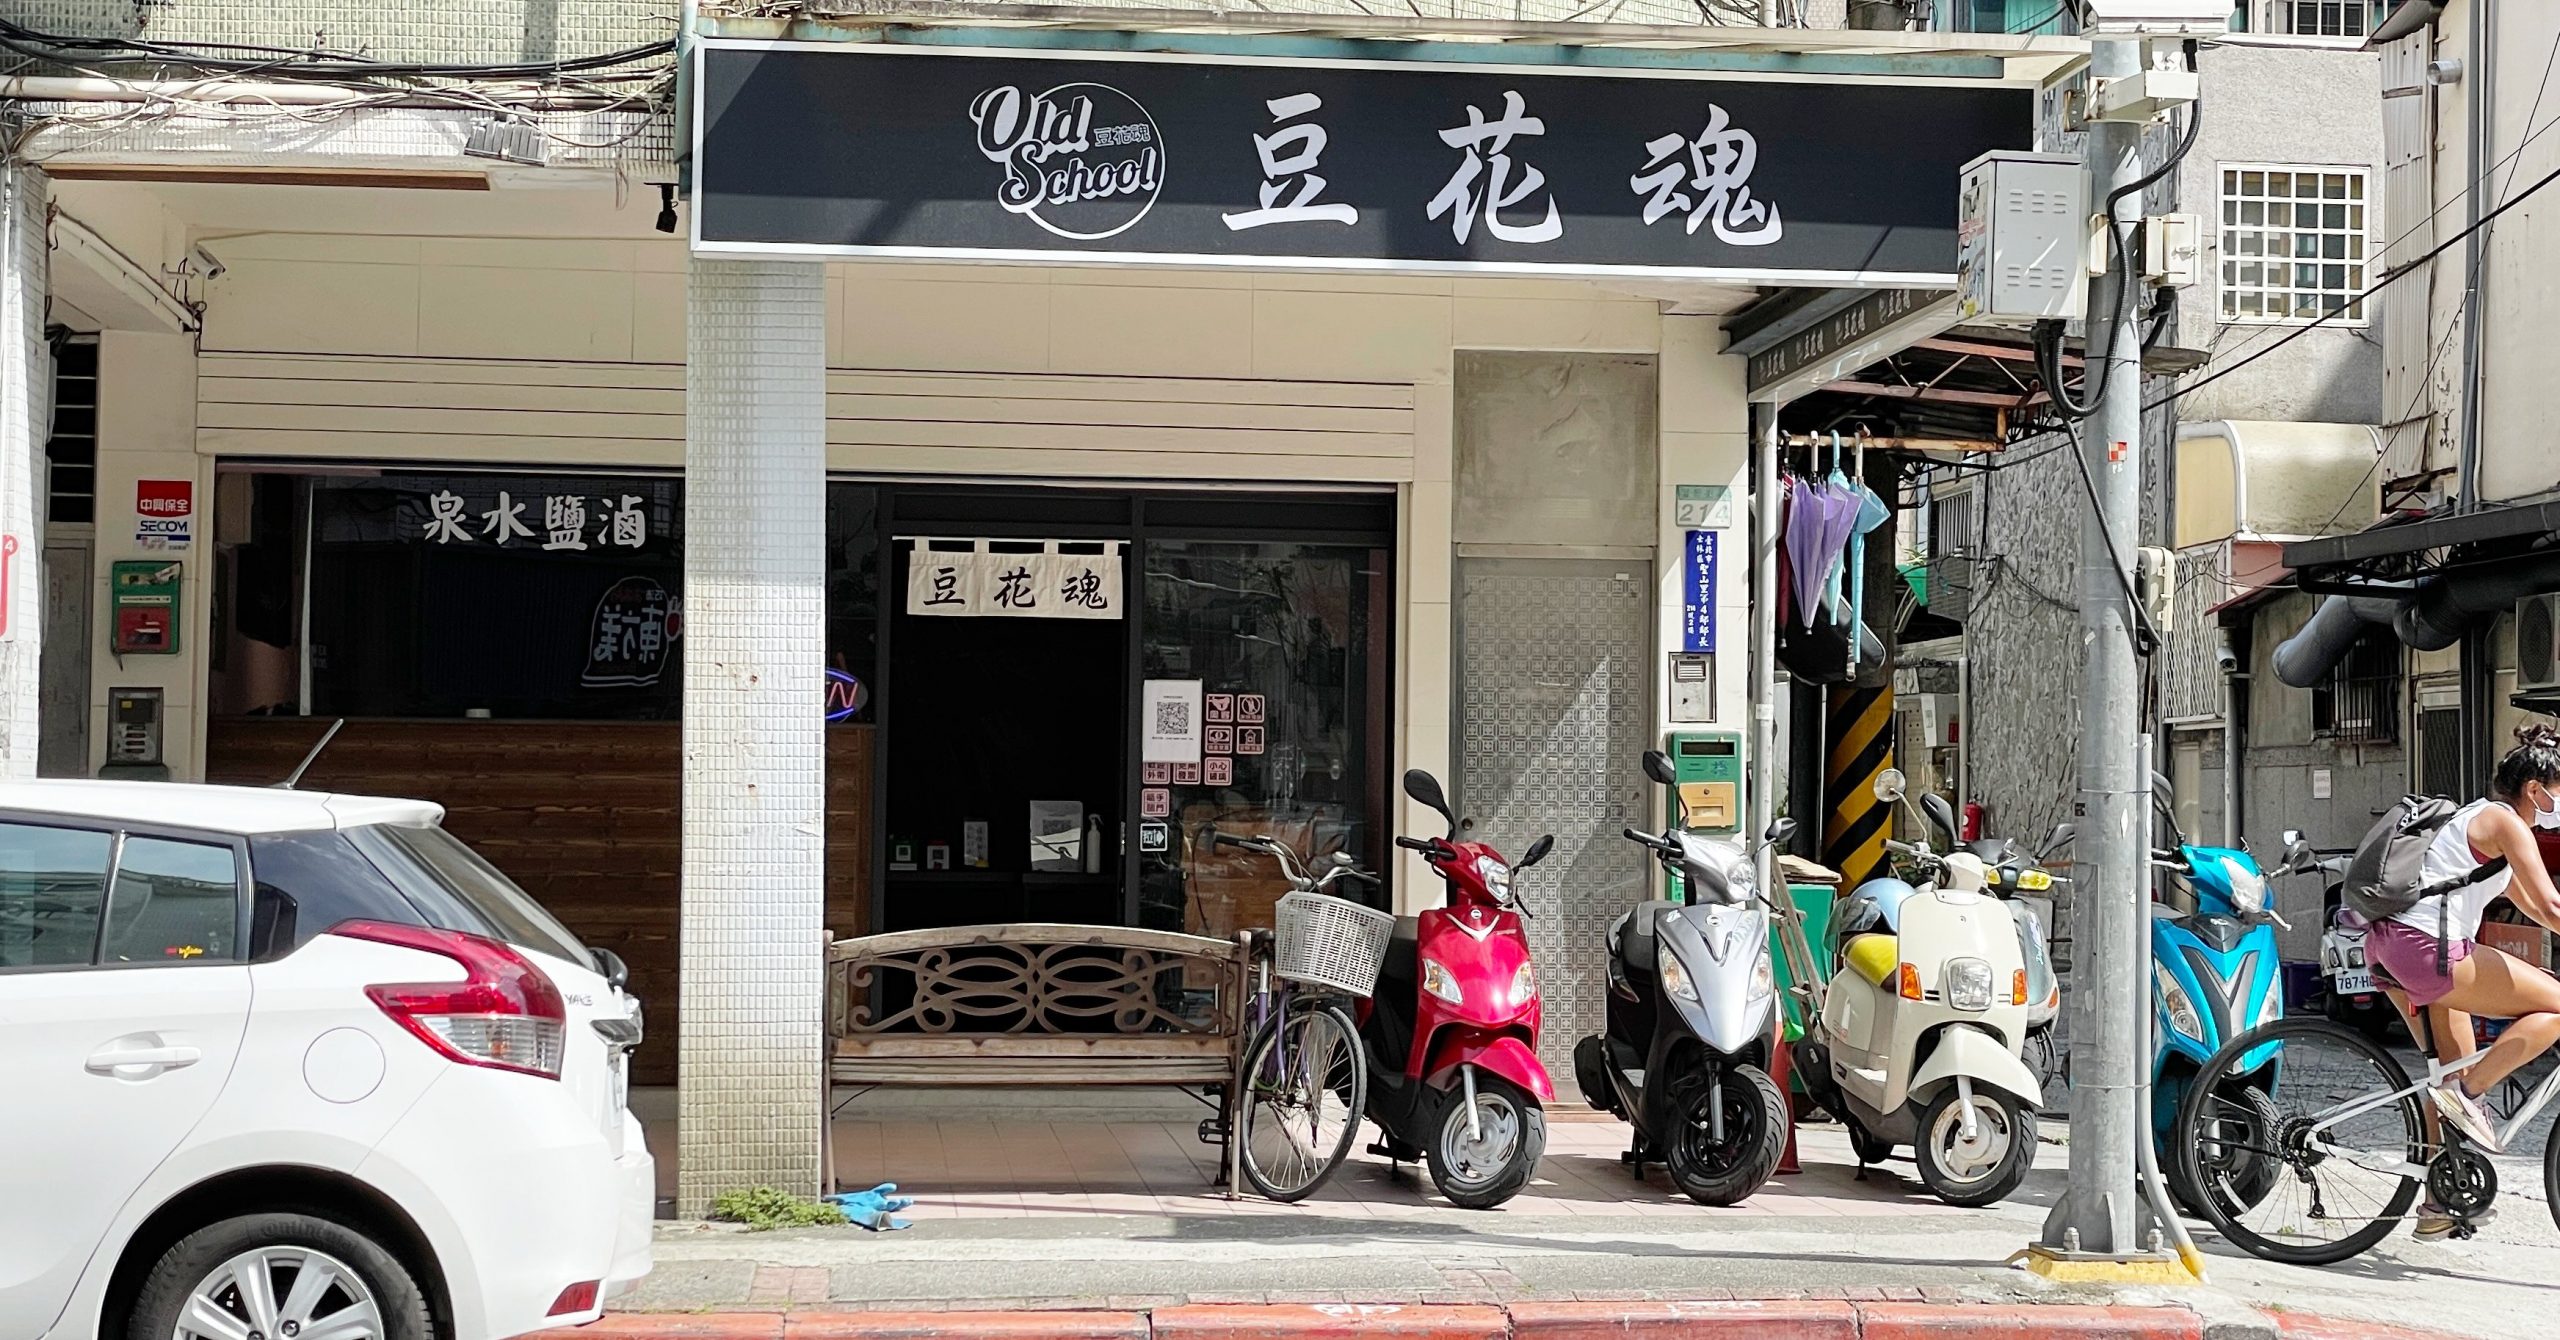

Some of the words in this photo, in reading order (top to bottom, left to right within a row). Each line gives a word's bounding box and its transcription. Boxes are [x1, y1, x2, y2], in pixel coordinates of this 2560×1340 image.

[969, 84, 1093, 163] Old
[1094, 124, 1151, 147] 豆花魂
[998, 138, 1157, 213] School
[1222, 90, 1783, 246] 豆花魂
[140, 520, 188, 532] SECOM
[422, 489, 646, 551] 泉水鹽滷
[923, 566, 1107, 609] 豆花魂
[1209, 762, 1227, 771] 小心
